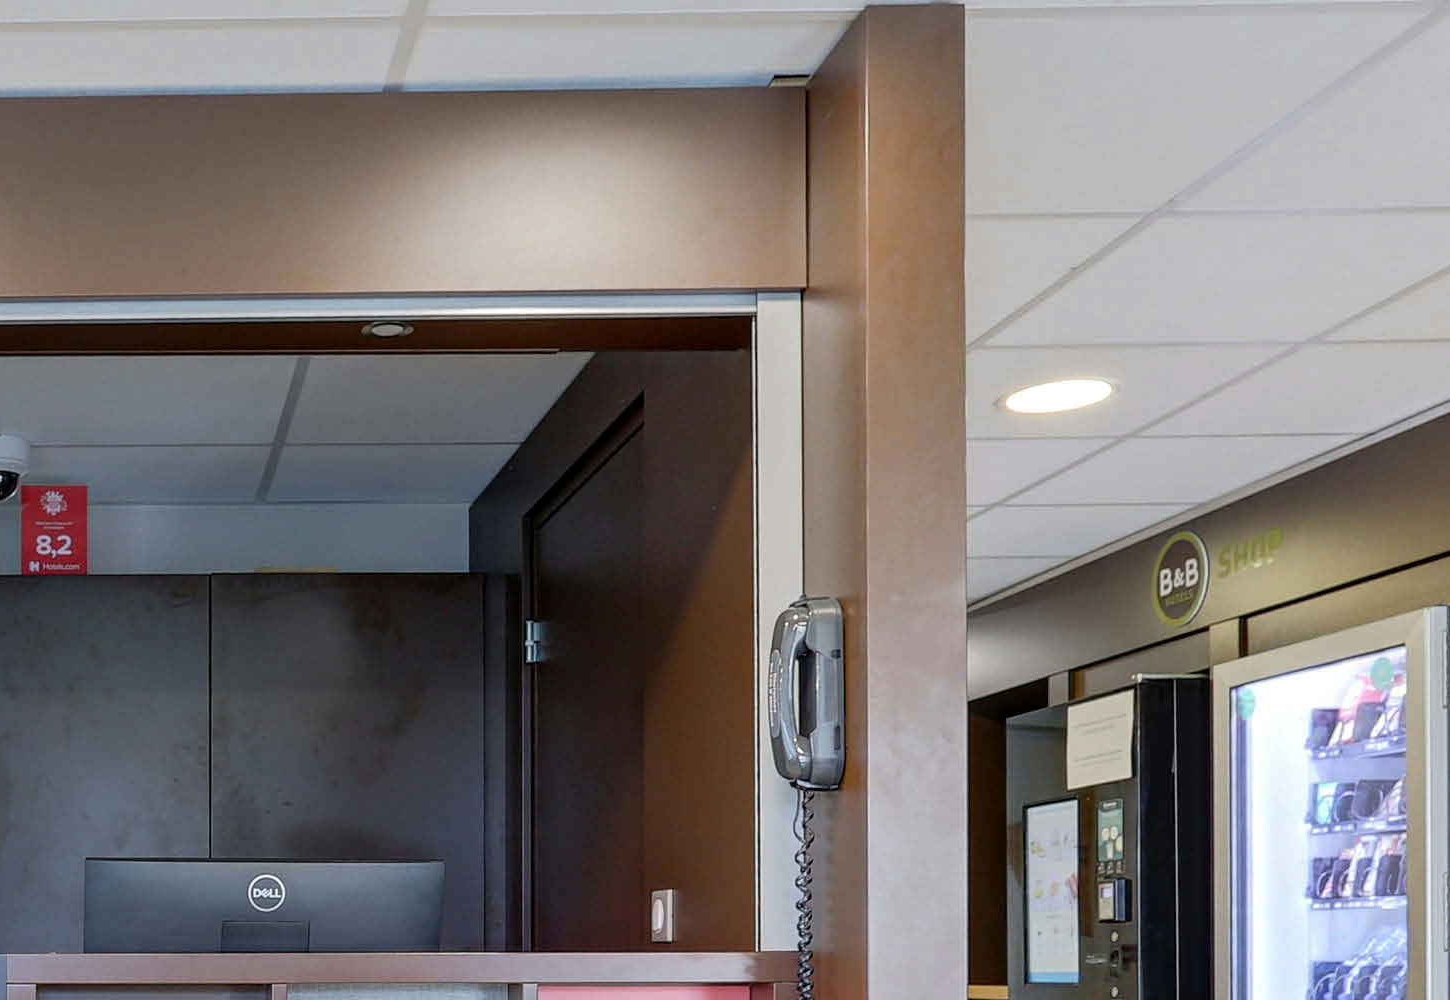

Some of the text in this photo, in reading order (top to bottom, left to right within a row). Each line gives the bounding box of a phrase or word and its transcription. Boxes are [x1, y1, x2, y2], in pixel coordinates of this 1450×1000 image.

[36, 534, 72, 559] 8,2
[1217, 527, 1285, 578] SHOP
[1160, 558, 1199, 597] B&B
[253, 888, 281, 898] DELL
